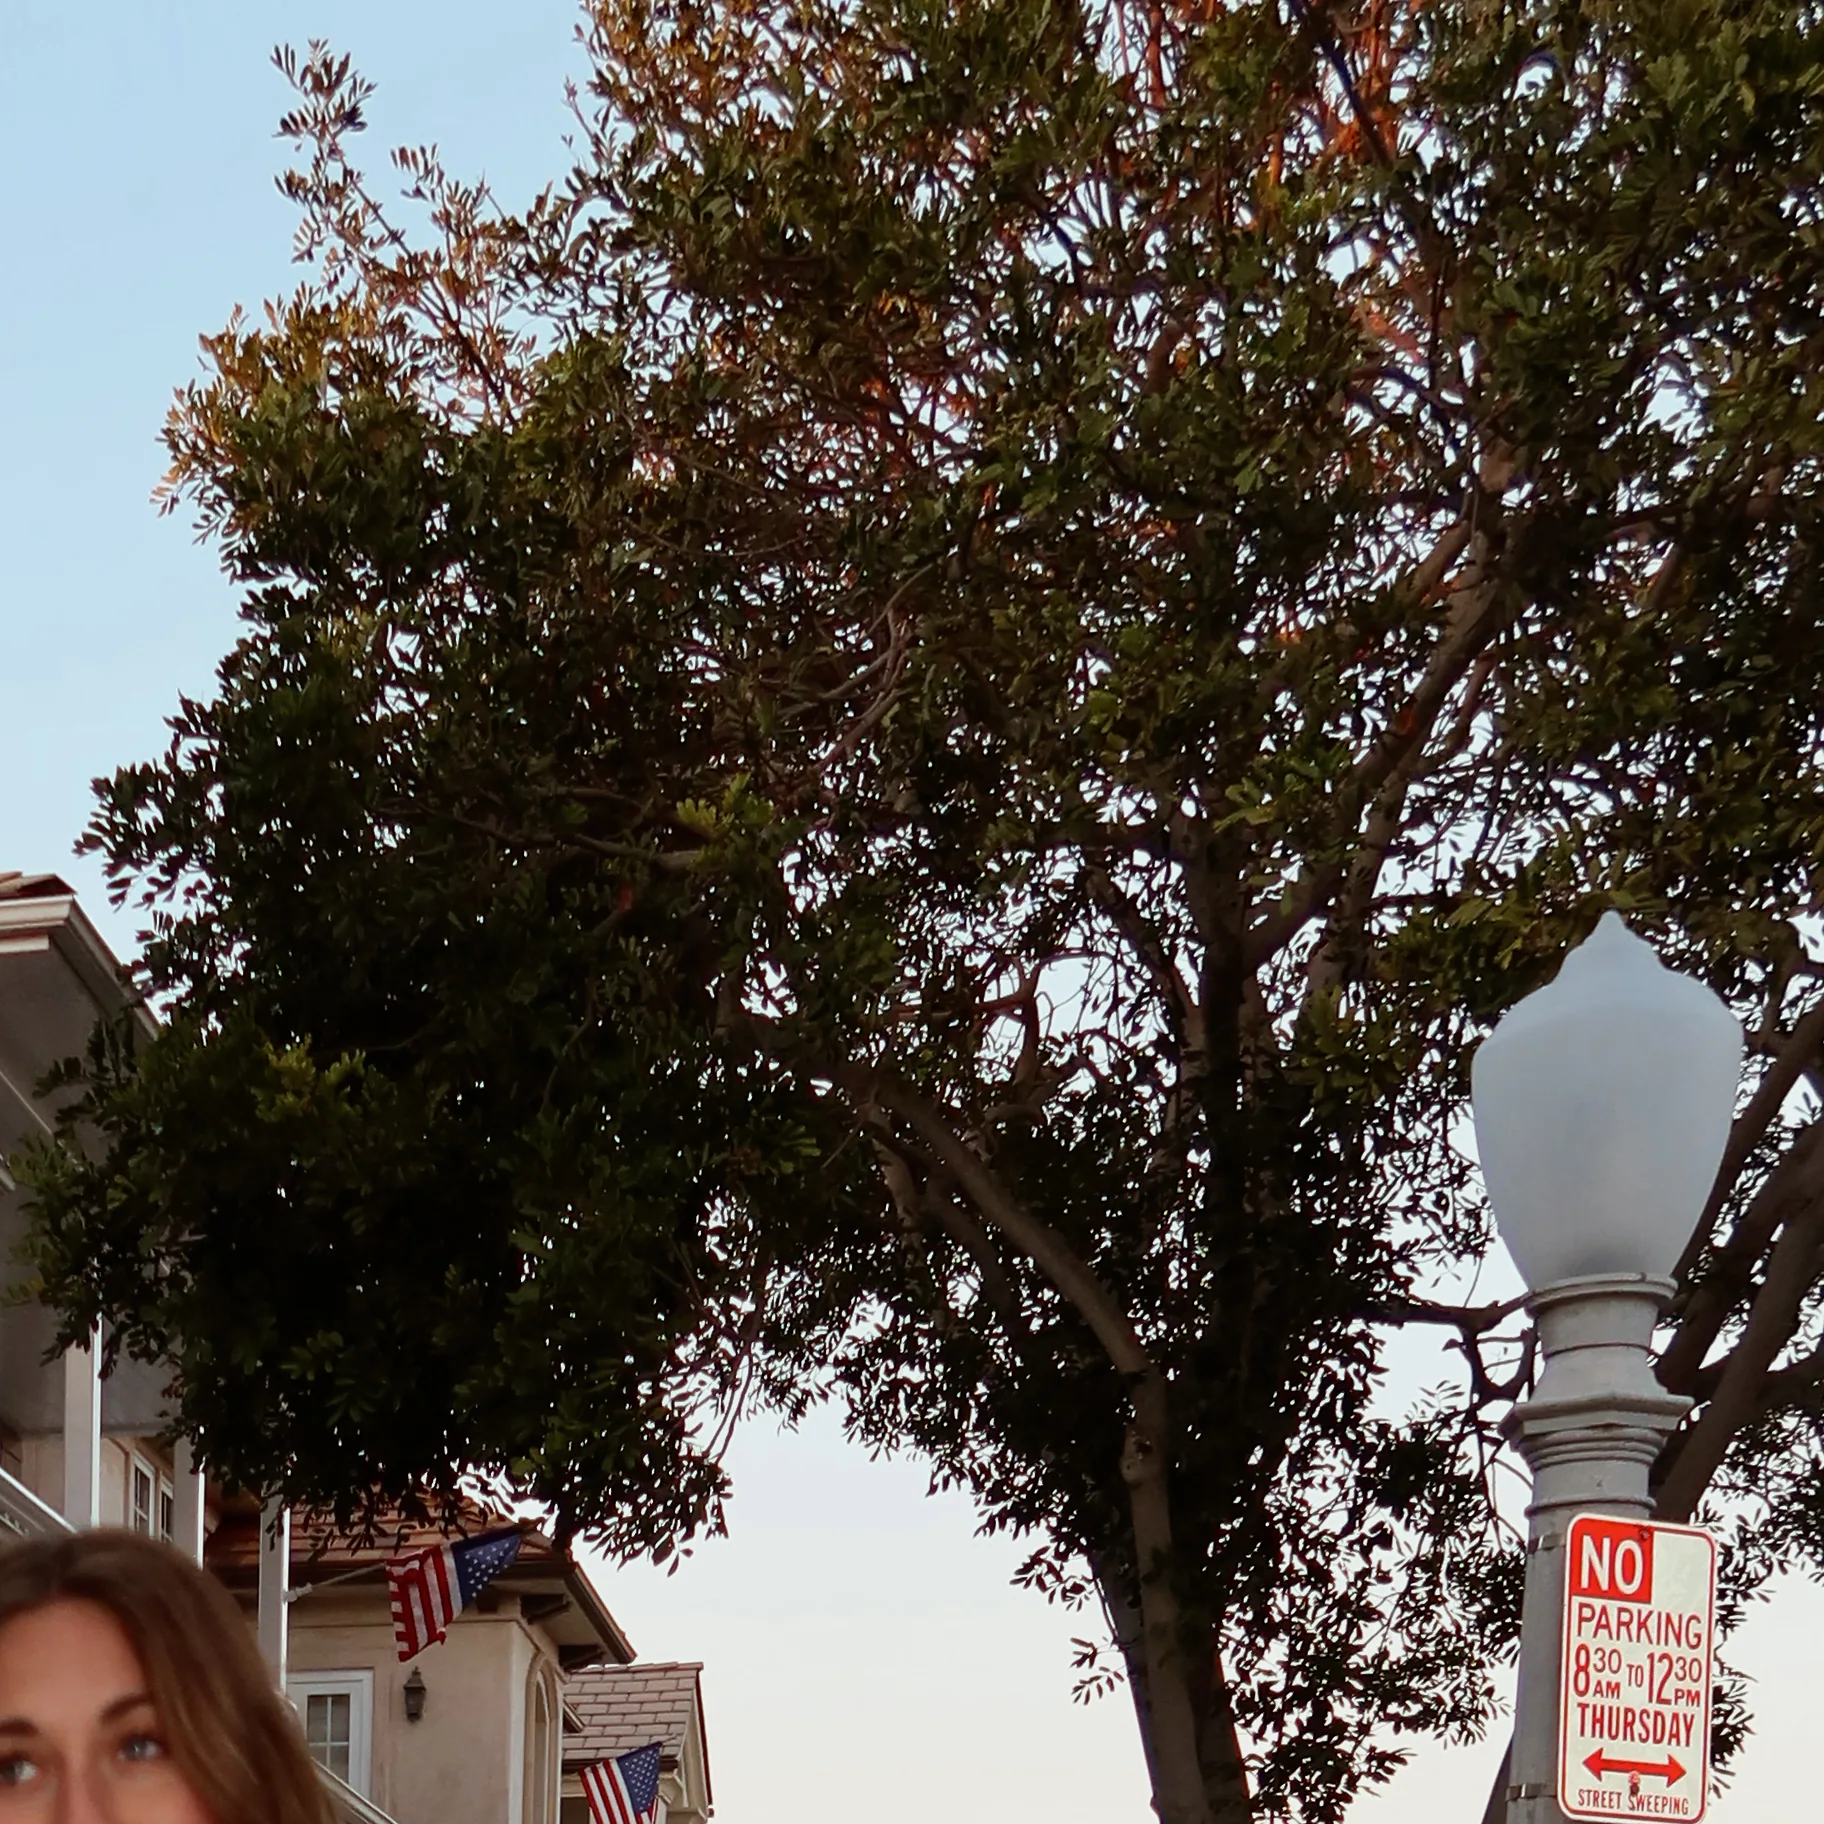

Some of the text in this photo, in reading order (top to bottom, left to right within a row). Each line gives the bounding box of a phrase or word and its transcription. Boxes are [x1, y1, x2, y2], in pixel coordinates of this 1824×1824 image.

[1580, 1534, 1643, 1595] NO
[1576, 1602, 1702, 1650] PARKING
[1592, 1679, 1622, 1699] AM
[1626, 1663, 1644, 1688] TO
[1674, 1687, 1701, 1708] PM
[1577, 1702, 1696, 1748] THURSDAY
[1578, 1788, 1622, 1809] STREET
[1628, 1793, 1690, 1816] SWEEPING
